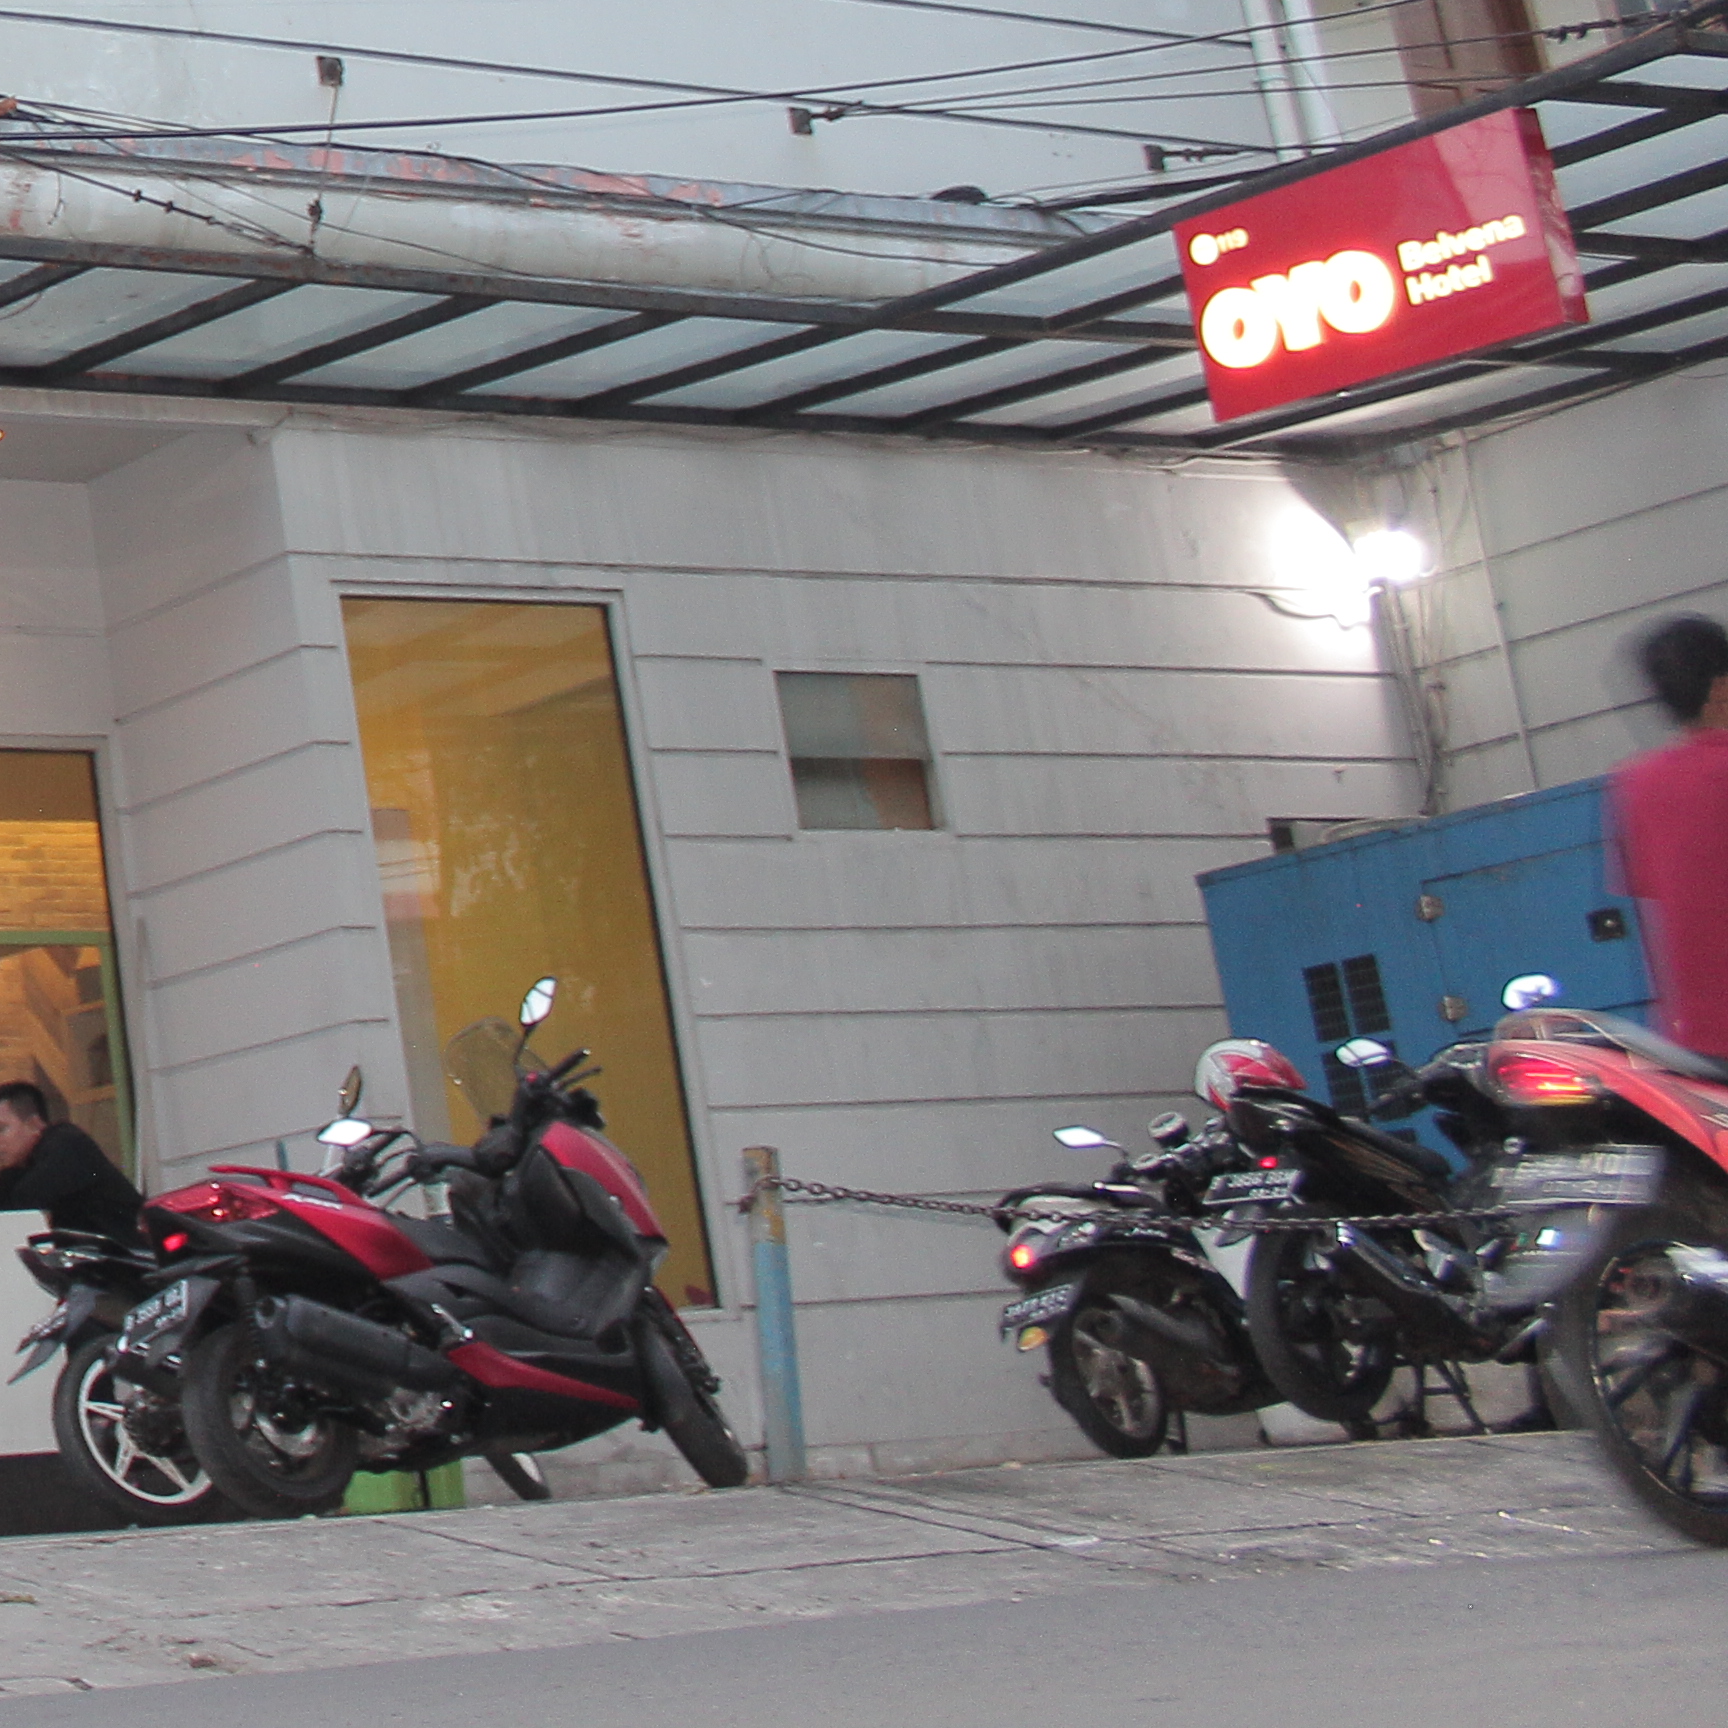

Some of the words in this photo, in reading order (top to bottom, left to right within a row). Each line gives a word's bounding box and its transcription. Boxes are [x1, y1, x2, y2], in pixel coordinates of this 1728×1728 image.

[1397, 214, 1526, 272] Belvena
[1200, 250, 1396, 370] OYO
[1405, 256, 1494, 306] Hotel
